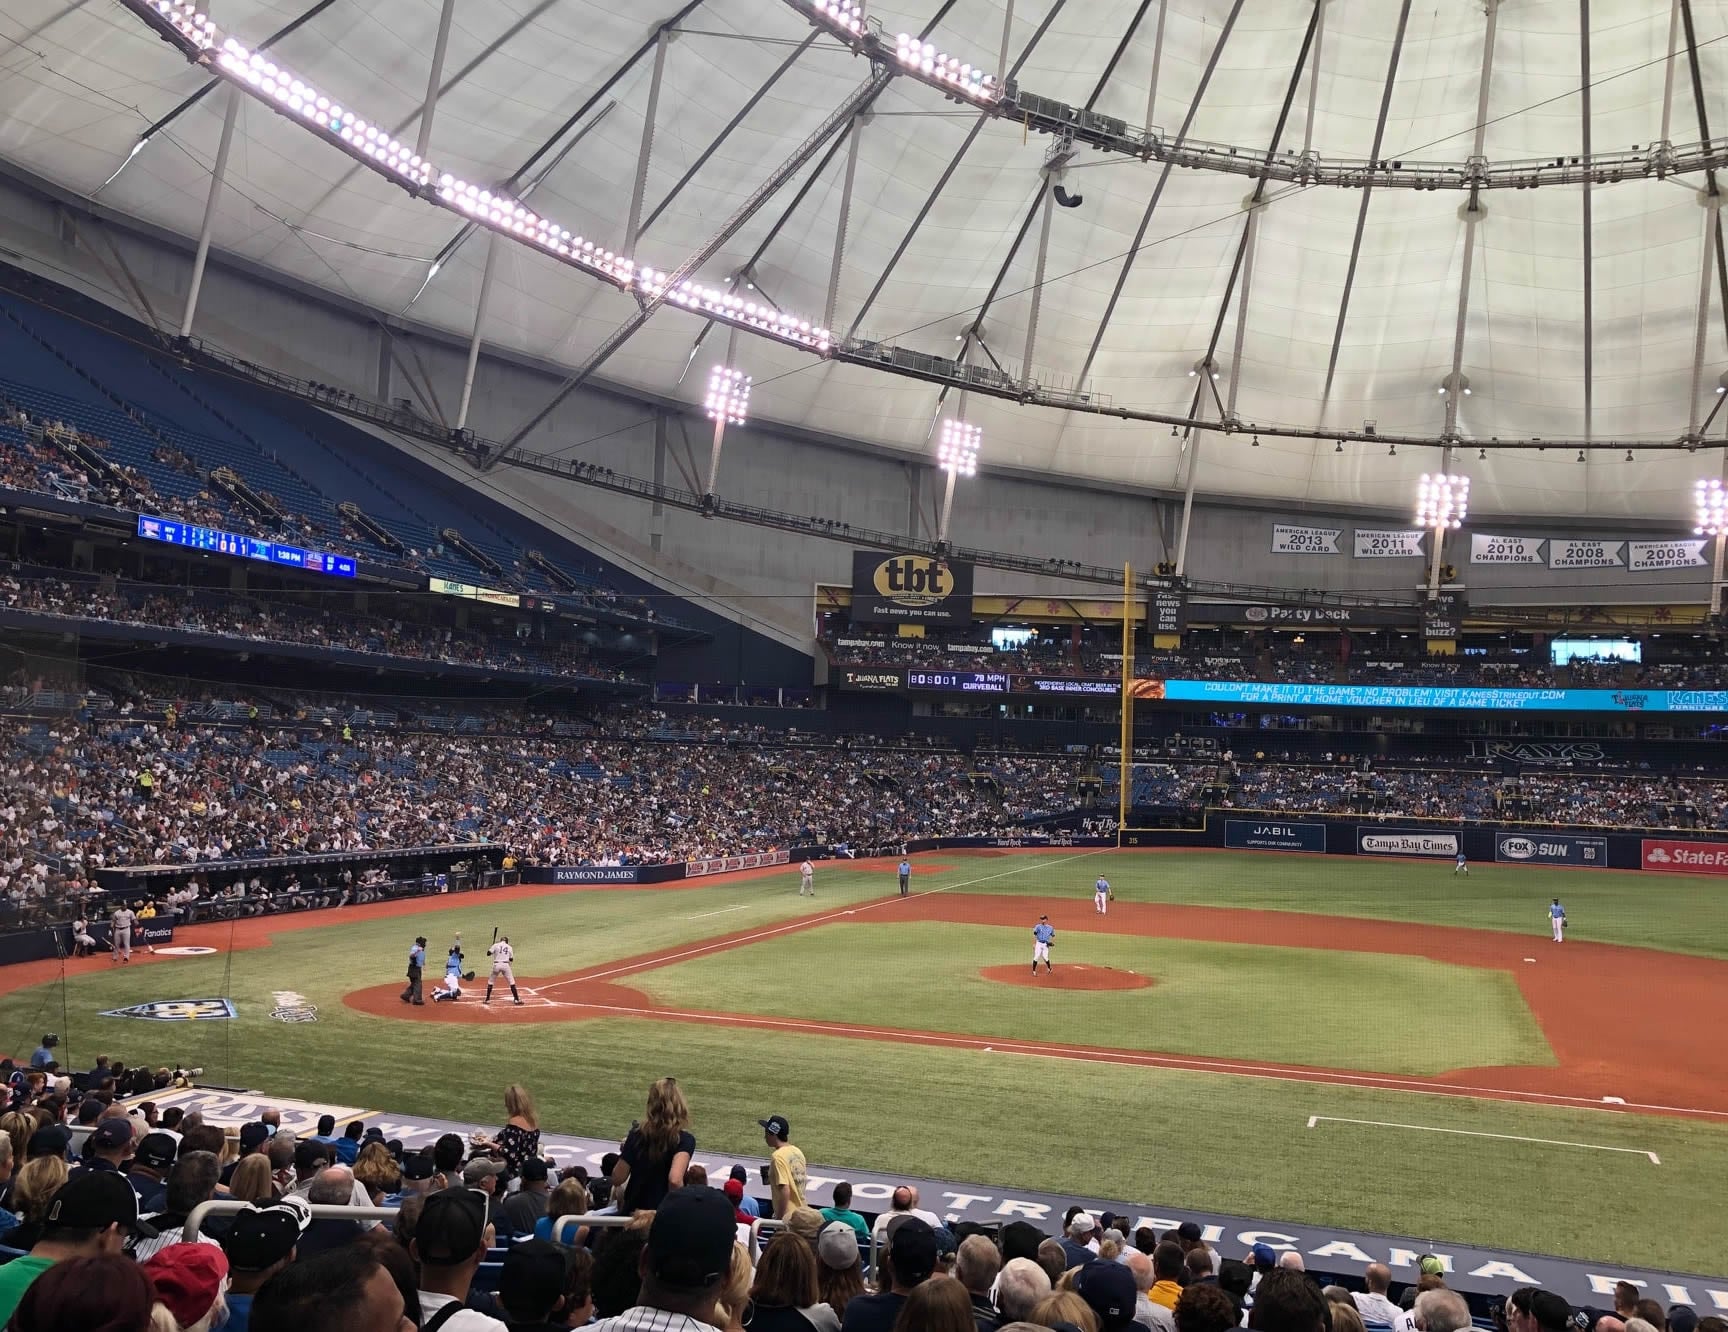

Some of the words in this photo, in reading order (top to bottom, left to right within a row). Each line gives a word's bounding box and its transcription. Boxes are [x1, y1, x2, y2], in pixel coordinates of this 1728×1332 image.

[1289, 534, 1322, 546] 2013
[1372, 538, 1406, 549] 2011
[220, 540, 226, 551] 0
[230, 542, 236, 553] 0
[1306, 544, 1330, 552] CARD
[1487, 544, 1524, 554] 2010
[290, 553, 300, 562] PM
[1476, 554, 1534, 562] CHAMPIONS
[1566, 548, 1604, 558] 2008
[1646, 549, 1686, 560] 2008
[1554, 558, 1614, 566] CHAMPIONS
[1634, 558, 1698, 568] CHAMPIONS
[884, 559, 944, 594] tbt
[874, 606, 888, 614] Fast
[1160, 608, 1176, 616] you
[1426, 627, 1456, 636] buzz?
[838, 638, 884, 648] tampabay.com
[892, 641, 915, 650] Know
[948, 644, 994, 653] tampabay.com
[986, 674, 1005, 683] MPH
[962, 682, 1003, 691] CURVEBALL
[1204, 682, 1248, 692] COULDN'T
[1252, 684, 1280, 693] MAKE
[1282, 686, 1290, 694] IT
[1292, 686, 1304, 694] TO
[1307, 686, 1325, 694] THE
[1328, 686, 1362, 696] GAME?
[1365, 688, 1379, 696] NO
[1382, 688, 1432, 698] PROBLEM!
[1434, 689, 1458, 698] VISIT
[1240, 692, 1260, 700] FOR
[1262, 693, 1269, 701] A
[1271, 694, 1300, 702] PRINT
[1301, 694, 1312, 703] AT
[1316, 694, 1343, 704] HOME
[1346, 696, 1393, 705] VOUCHER
[1394, 696, 1406, 705] IN
[1409, 697, 1430, 706] LIEU
[1434, 698, 1446, 706] OF
[1449, 698, 1456, 706] A
[1458, 698, 1488, 707] GAME
[1490, 698, 1526, 708] TICKET
[1465, 740, 1605, 763] RAYS
[1253, 826, 1296, 836] JABIL
[1366, 838, 1399, 850] Tampa
[1400, 838, 1421, 852] Bay
[1422, 839, 1454, 850] Times
[1508, 842, 1528, 850] FOX
[1538, 843, 1568, 857] SUN
[557, 871, 604, 880] RAYMOND
[604, 870, 634, 879] JAMES
[144, 928, 172, 938] Fanatics
[500, 946, 509, 955] 14
